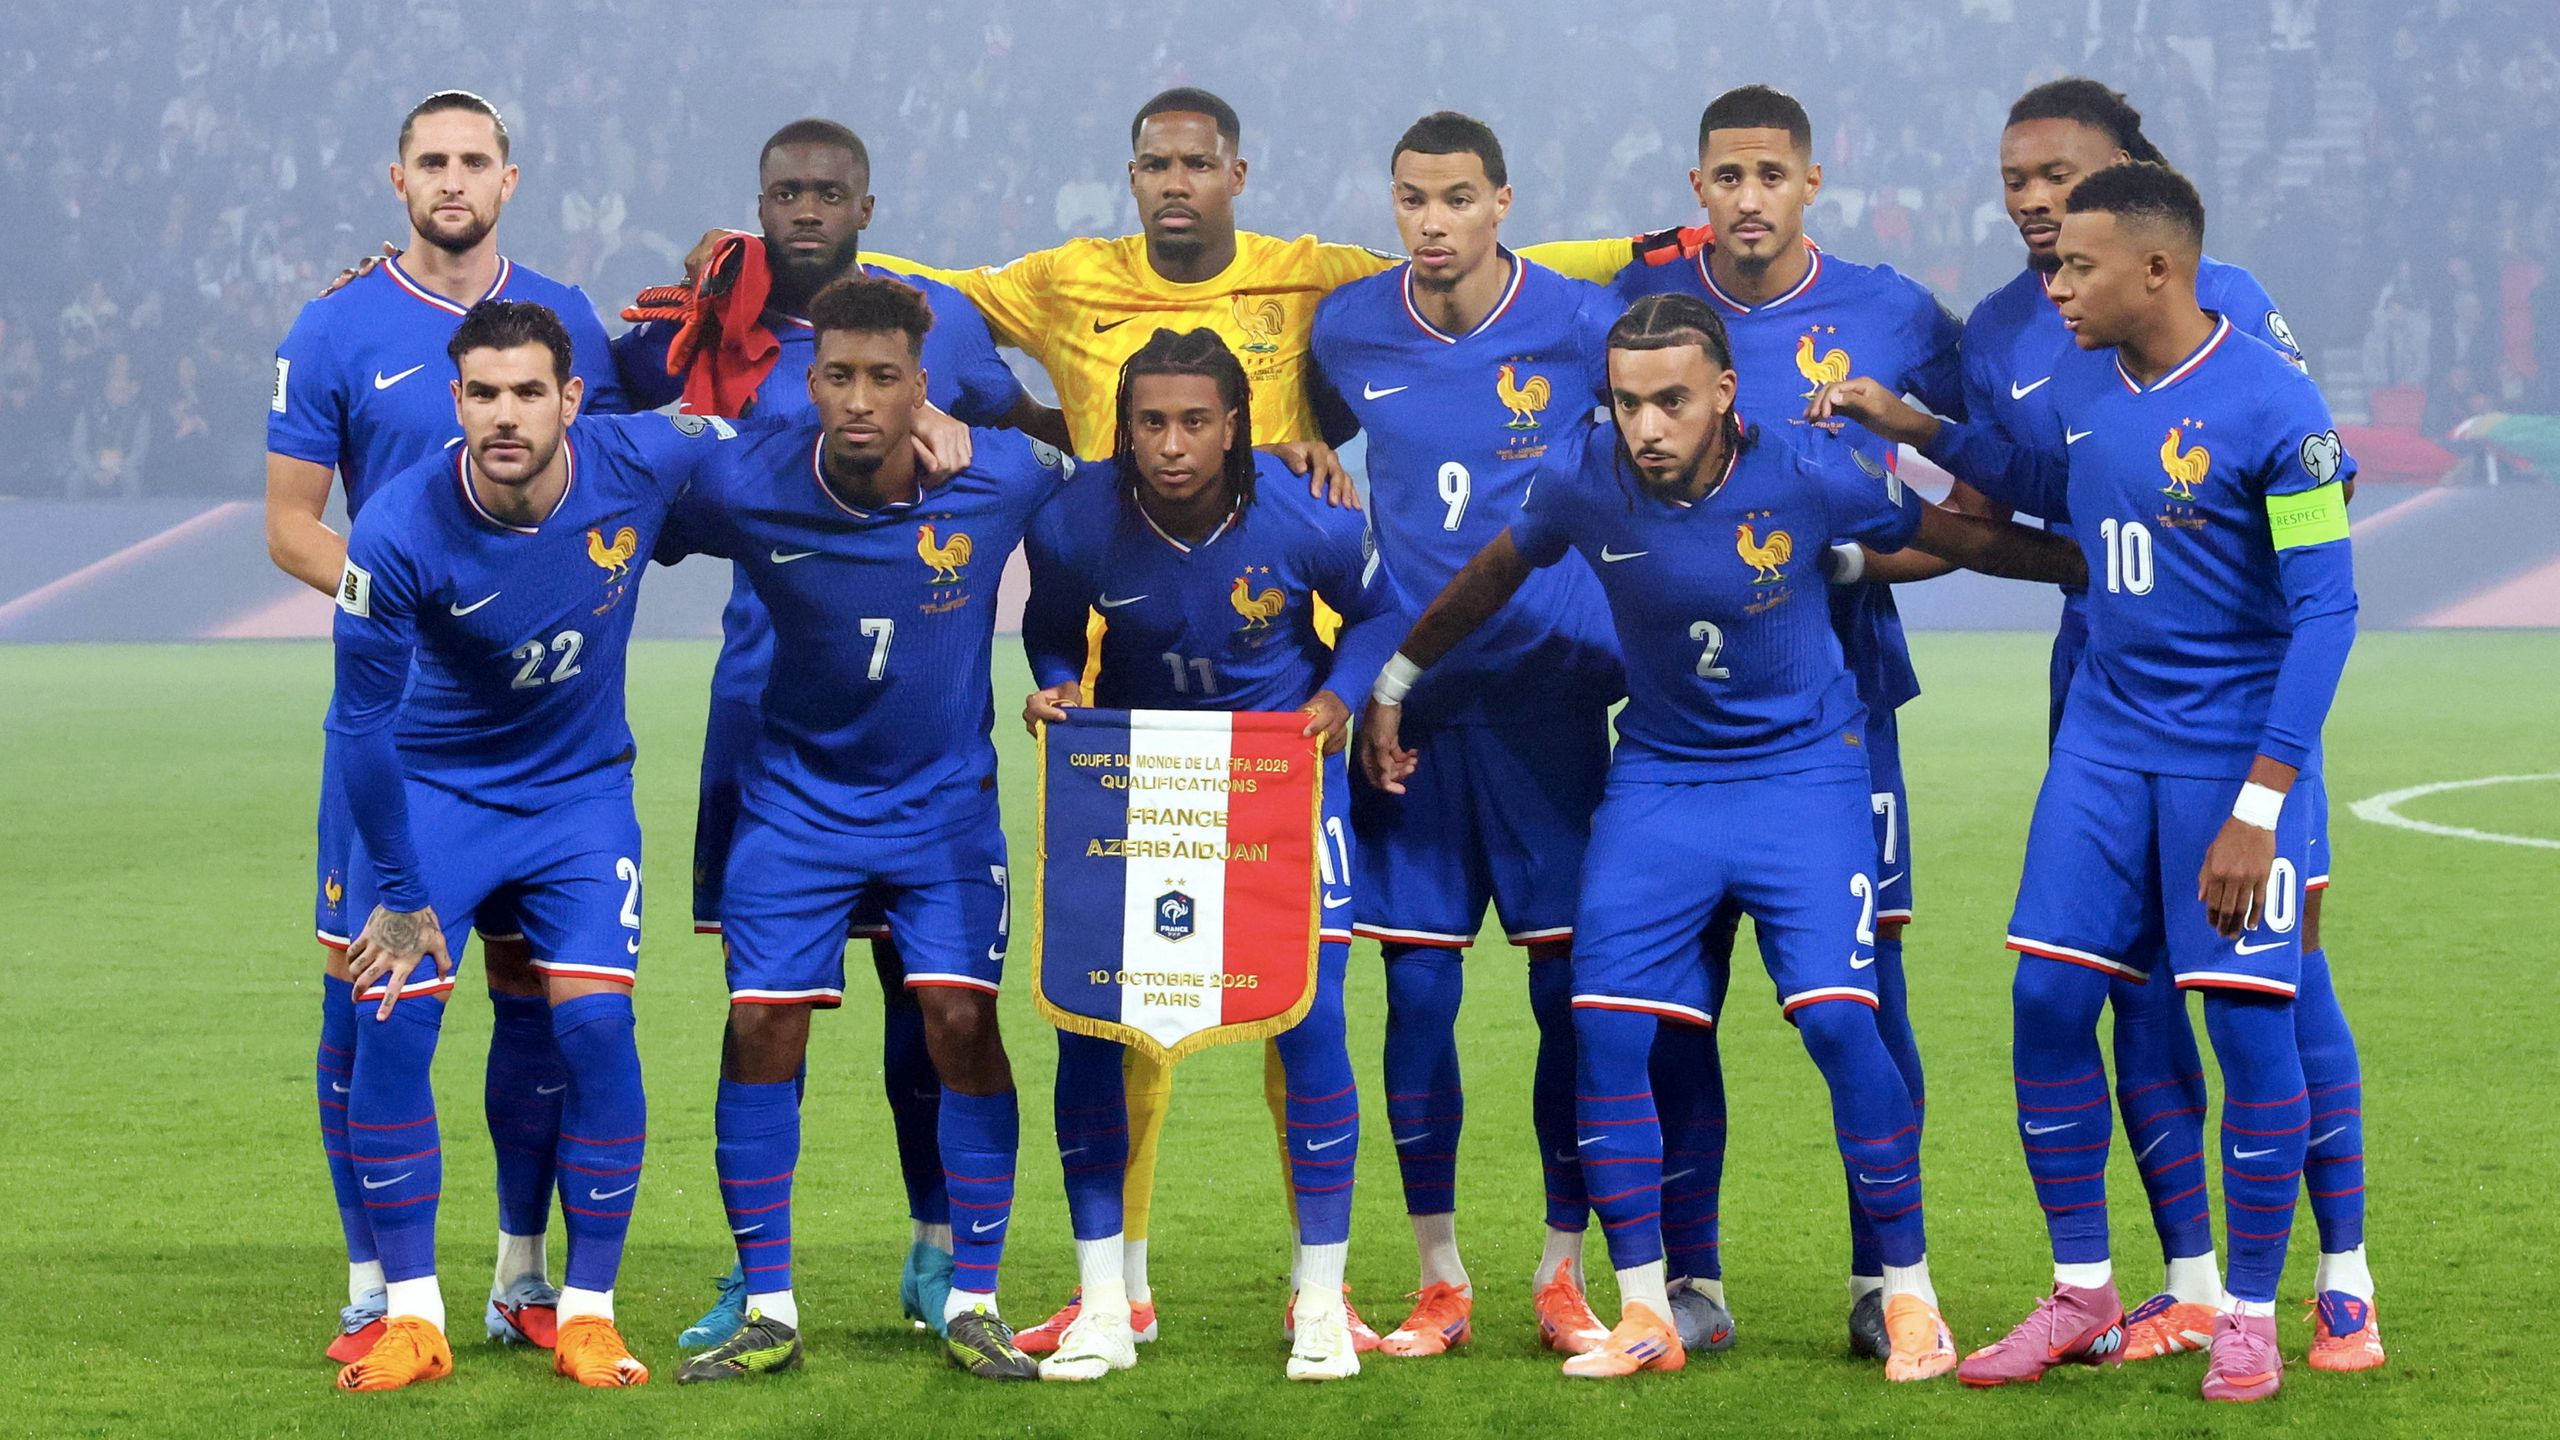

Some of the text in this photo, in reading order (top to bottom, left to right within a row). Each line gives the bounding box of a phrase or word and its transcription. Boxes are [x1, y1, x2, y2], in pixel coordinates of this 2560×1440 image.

[1438, 461, 1471, 531] 9
[2276, 508, 2327, 526] RESPECT
[2100, 517, 2154, 596] 10
[511, 629, 584, 690] 22
[860, 618, 895, 681] 7
[1689, 620, 1731, 679] 2
[1162, 652, 1218, 695] 11
[1070, 753, 1289, 773] COUPE DU MONDE DE LA FIFA 2026
[1100, 774, 1258, 793] QUALIFICATIONS
[1125, 807, 1230, 828] FRANCE
[1085, 838, 1269, 863] AZERBAIDJAN
[1850, 873, 1874, 947] 2
[1160, 925, 1189, 933] FRANCE
[1087, 969, 1259, 989] 10 OCTOBRE 2025
[1143, 992, 1202, 1008] PARIS
